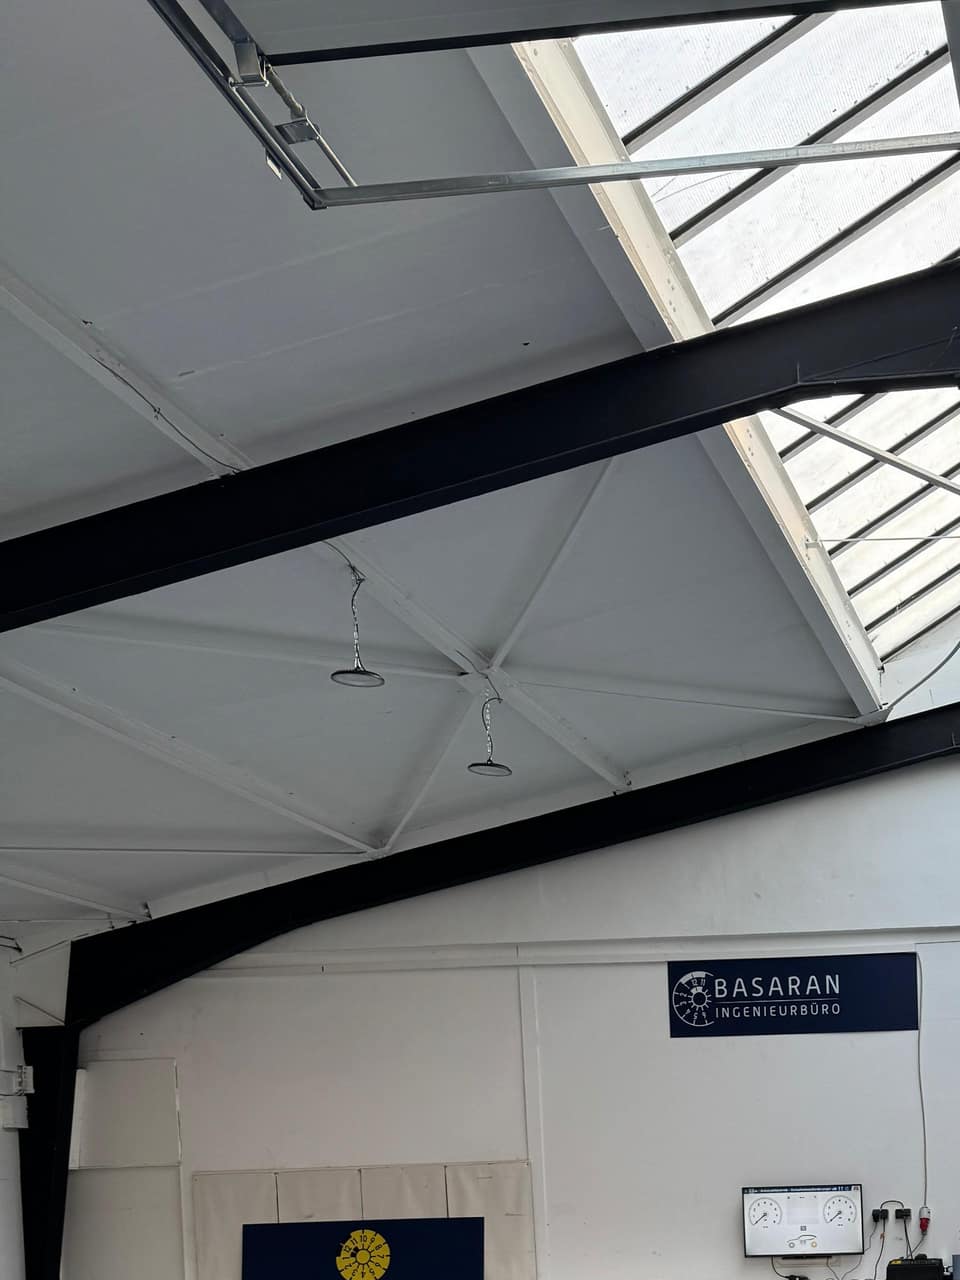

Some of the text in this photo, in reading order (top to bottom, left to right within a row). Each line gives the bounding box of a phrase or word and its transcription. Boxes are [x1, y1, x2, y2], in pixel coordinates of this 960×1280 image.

[714, 974, 840, 998] BASARAN
[714, 1002, 841, 1019] INGENIEURBÜRO
[351, 1238, 358, 1246] 11
